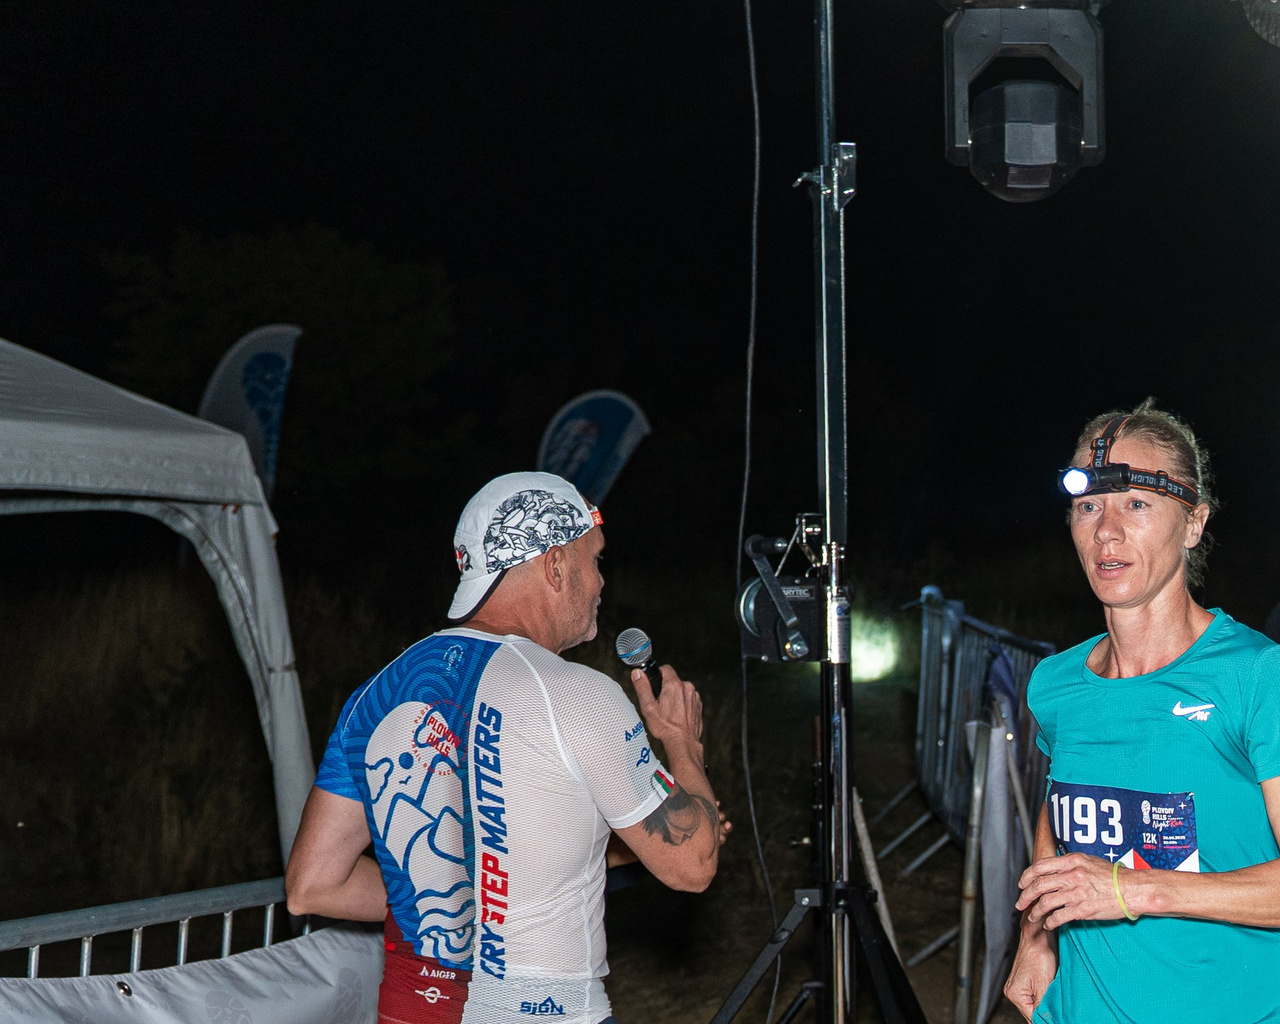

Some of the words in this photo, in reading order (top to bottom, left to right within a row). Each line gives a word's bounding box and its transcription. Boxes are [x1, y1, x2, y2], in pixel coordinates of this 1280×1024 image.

[1167, 482, 1183, 496] LED
[426, 732, 451, 758] HILLS
[427, 715, 462, 749] PLOVDIV
[474, 702, 509, 854] MATTERS
[1051, 793, 1124, 846] 1193
[1142, 832, 1158, 845] 12K
[480, 852, 508, 924] STEP
[430, 969, 457, 980] AIGER
